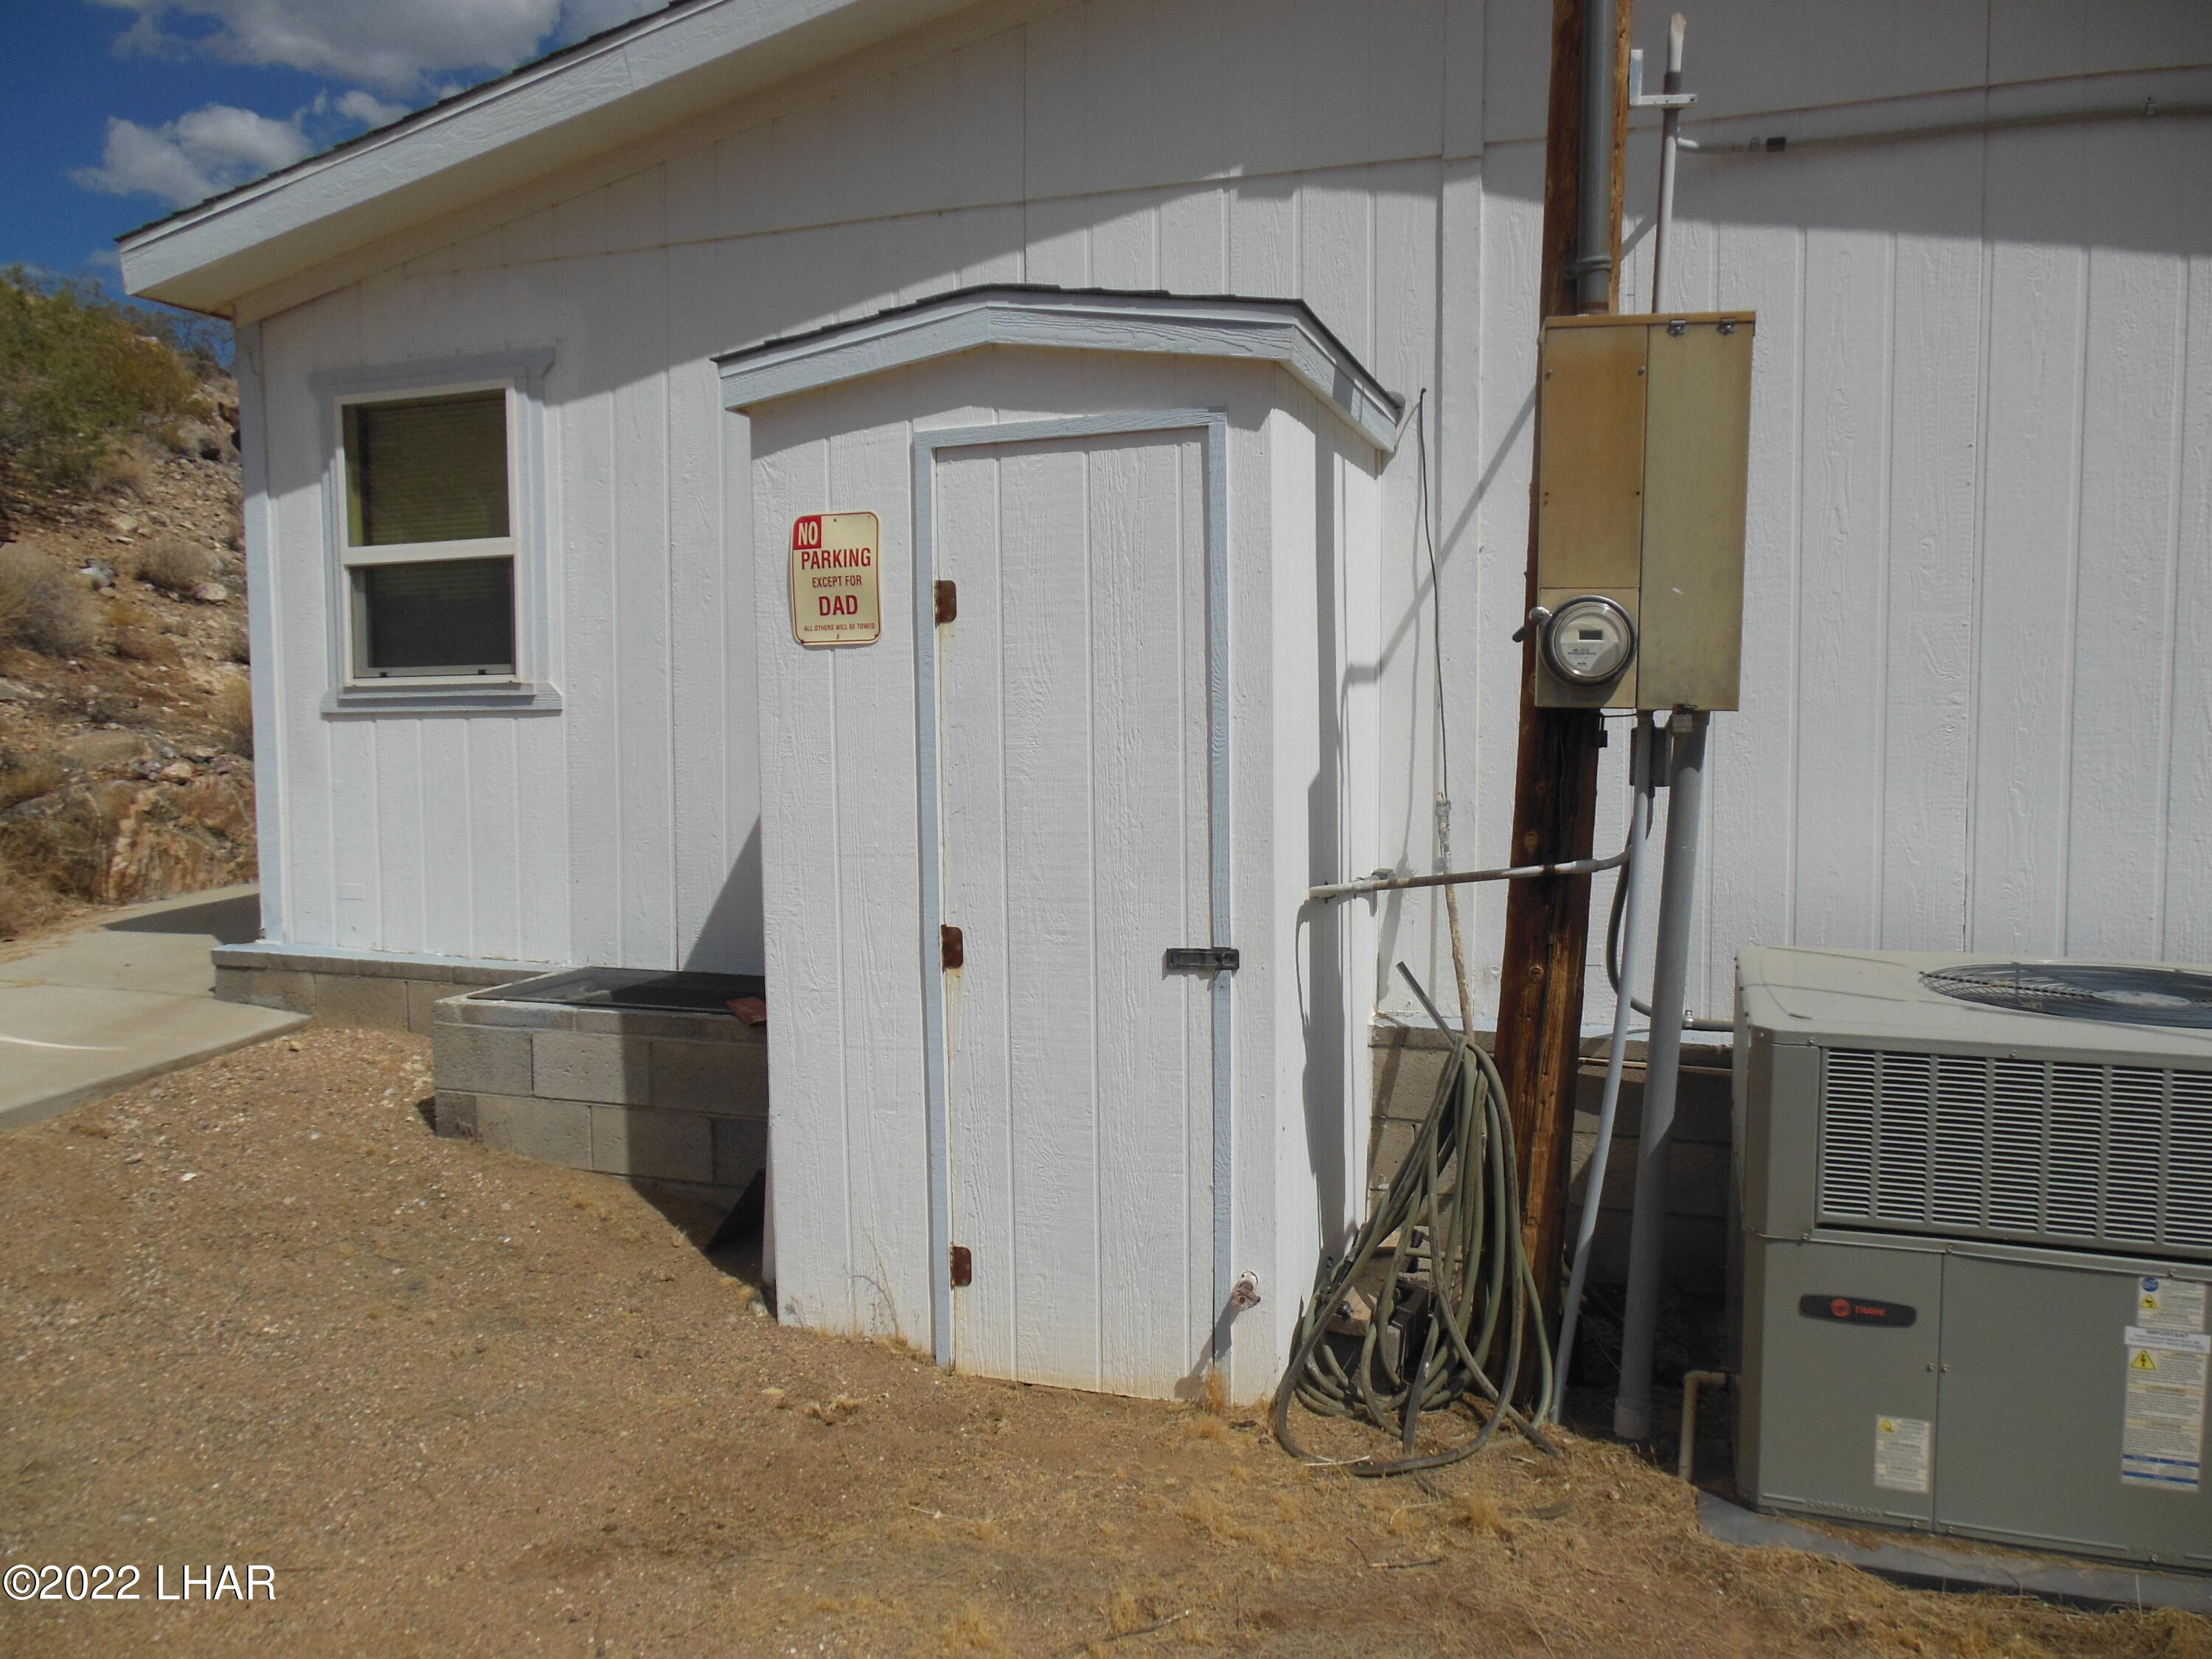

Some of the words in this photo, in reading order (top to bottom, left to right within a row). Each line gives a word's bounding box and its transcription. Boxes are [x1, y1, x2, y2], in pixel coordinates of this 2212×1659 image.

[798, 521, 818, 546] NO
[801, 547, 872, 570] PARKING
[812, 576, 842, 588] EXCEPT
[845, 574, 862, 587] FOR
[818, 594, 858, 616] DAD
